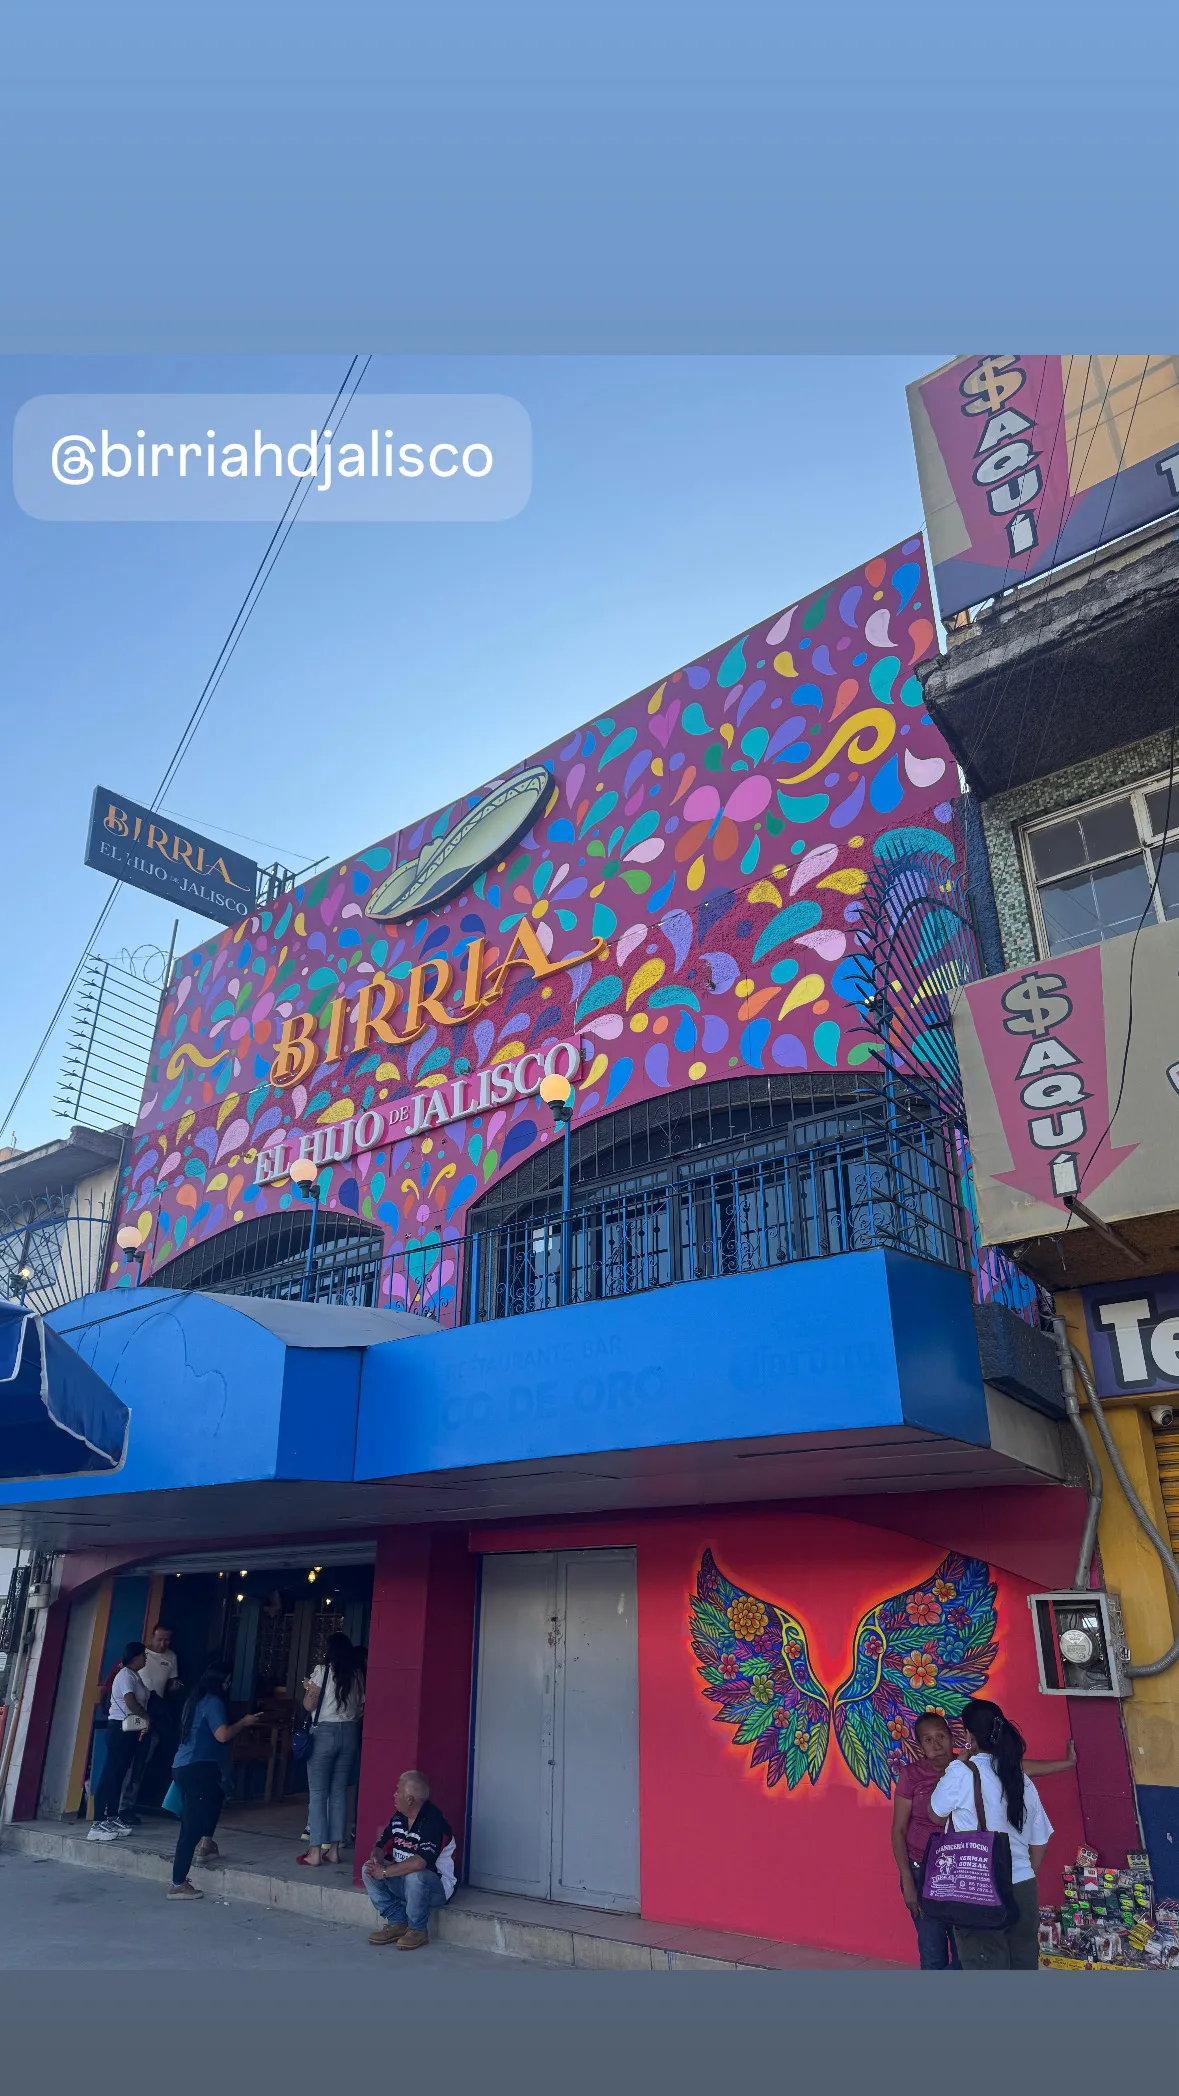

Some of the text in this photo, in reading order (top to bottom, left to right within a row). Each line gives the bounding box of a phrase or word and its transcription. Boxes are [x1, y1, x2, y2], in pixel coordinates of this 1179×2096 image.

[100, 841, 121, 861] EL
[126, 852, 168, 881] HIJO
[179, 877, 248, 916] JALISCO
[103, 804, 250, 892] BIRRIA
[270, 917, 608, 1089] BIRRIA
[254, 1042, 581, 1186] EL HIJO DE JALISCO
[1092, 1293, 1179, 1388] Te
